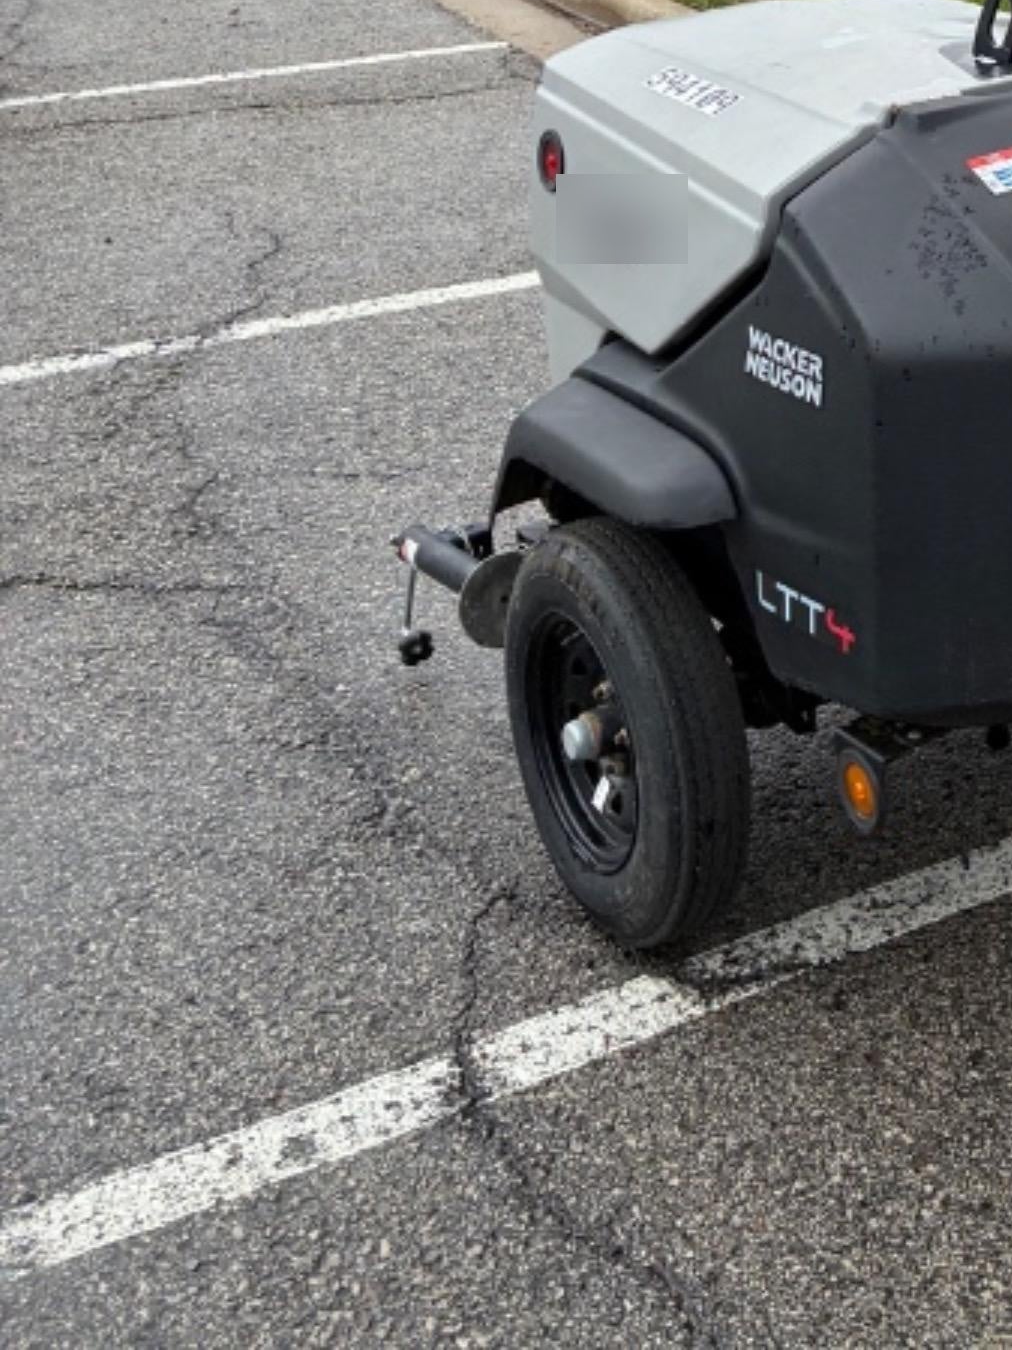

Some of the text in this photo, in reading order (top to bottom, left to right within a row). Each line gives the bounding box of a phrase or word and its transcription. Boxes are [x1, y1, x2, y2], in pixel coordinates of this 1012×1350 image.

[744, 350, 823, 408] NEUSON
[748, 324, 823, 382] WACKER
[756, 570, 856, 654] LTT4
